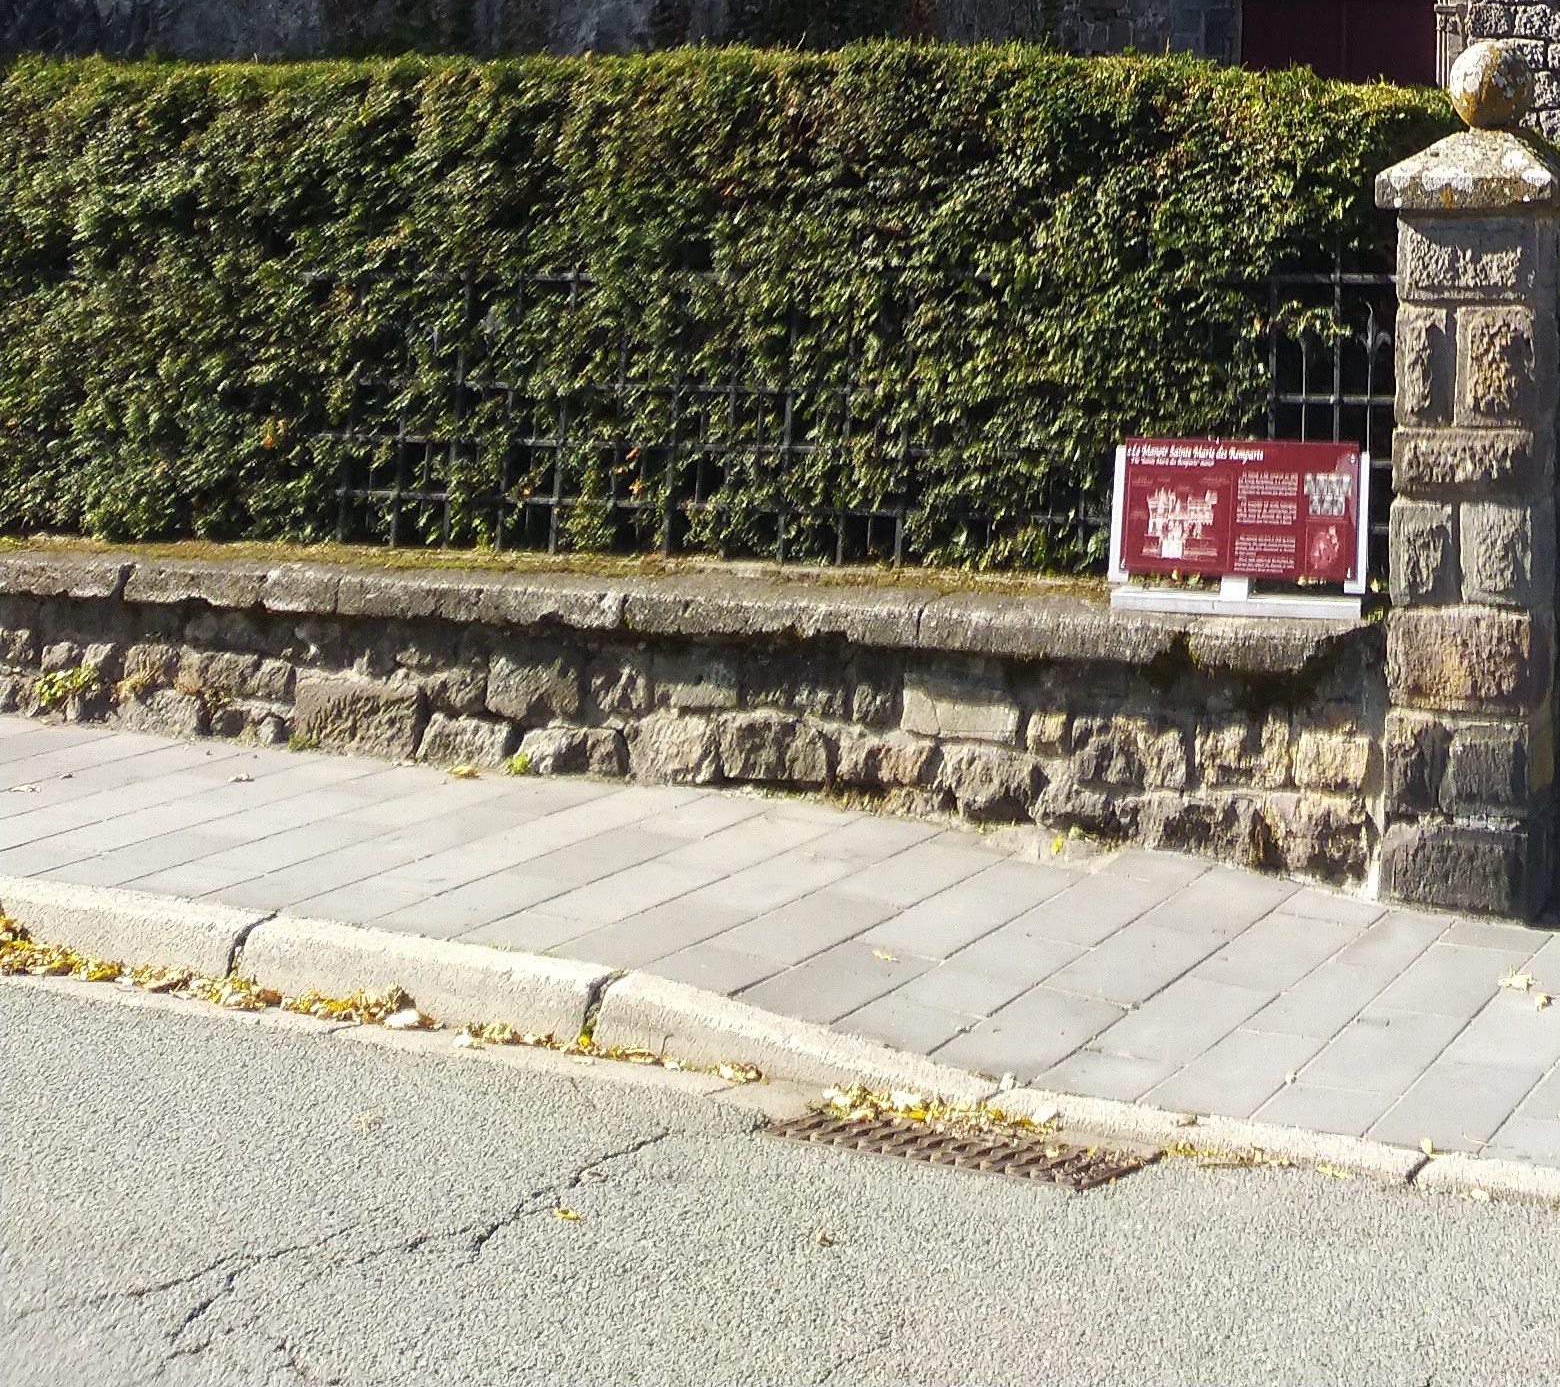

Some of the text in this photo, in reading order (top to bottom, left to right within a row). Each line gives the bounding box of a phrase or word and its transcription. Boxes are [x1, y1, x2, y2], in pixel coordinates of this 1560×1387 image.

[1193, 445, 1215, 458] Marie
[1216, 445, 1227, 459] des
[1229, 446, 1264, 465] Remparts
